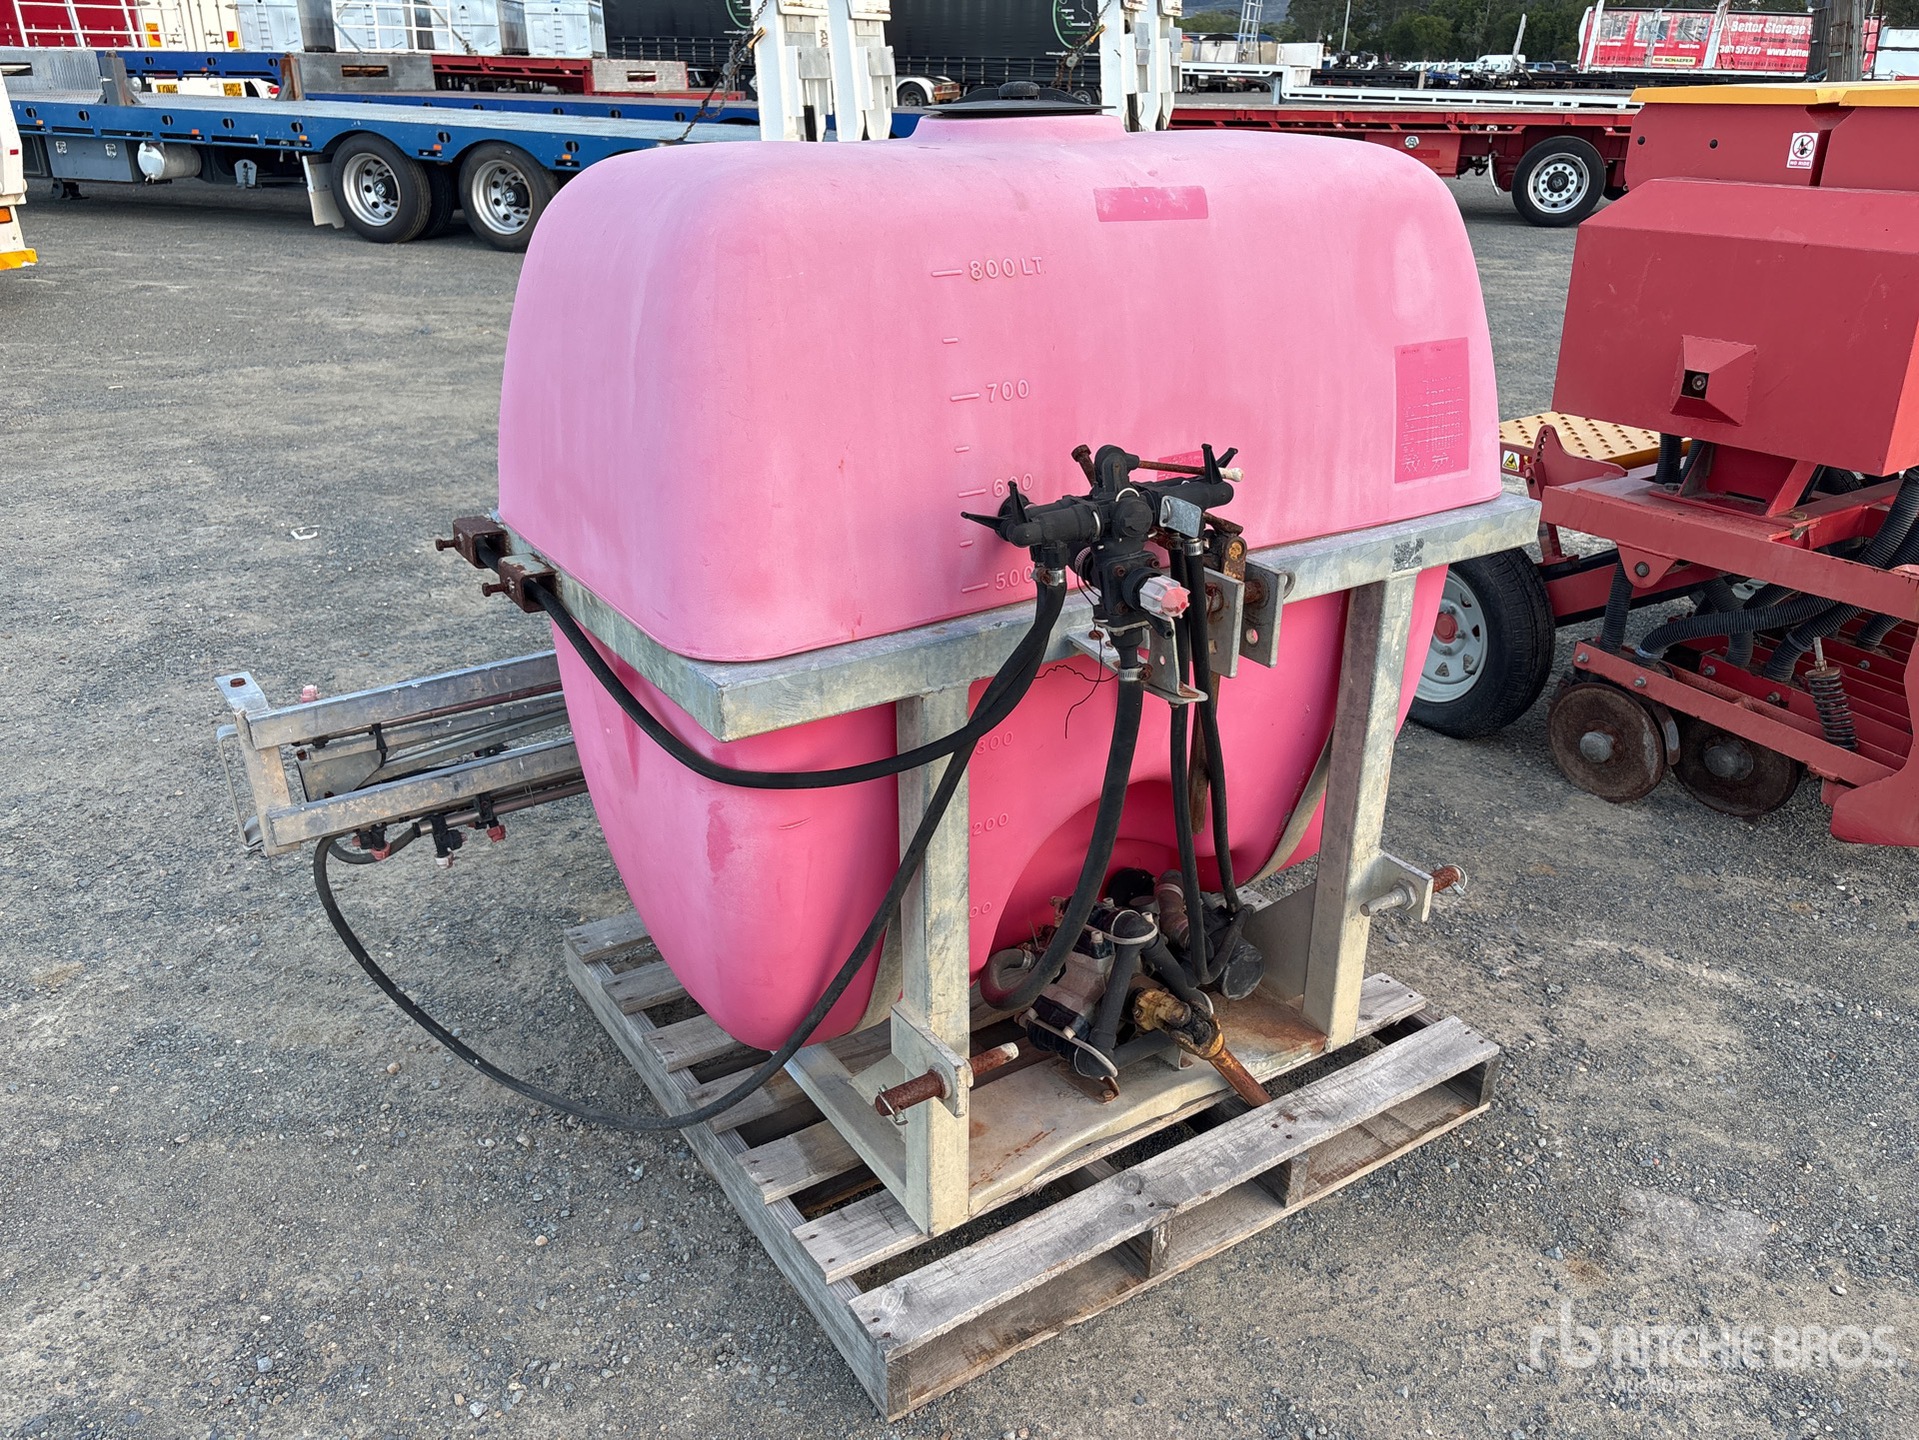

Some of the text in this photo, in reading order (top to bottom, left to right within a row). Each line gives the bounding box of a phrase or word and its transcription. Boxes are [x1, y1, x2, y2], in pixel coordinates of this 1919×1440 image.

[1731, 21, 1764, 33] Better
[1764, 22, 1808, 35] Storage
[1736, 46, 1749, 54] 571
[1748, 46, 1761, 55] 277
[969, 257, 1016, 281] 800
[986, 379, 1030, 402] 700
[975, 731, 1014, 755] 300
[972, 812, 1009, 836] 200
